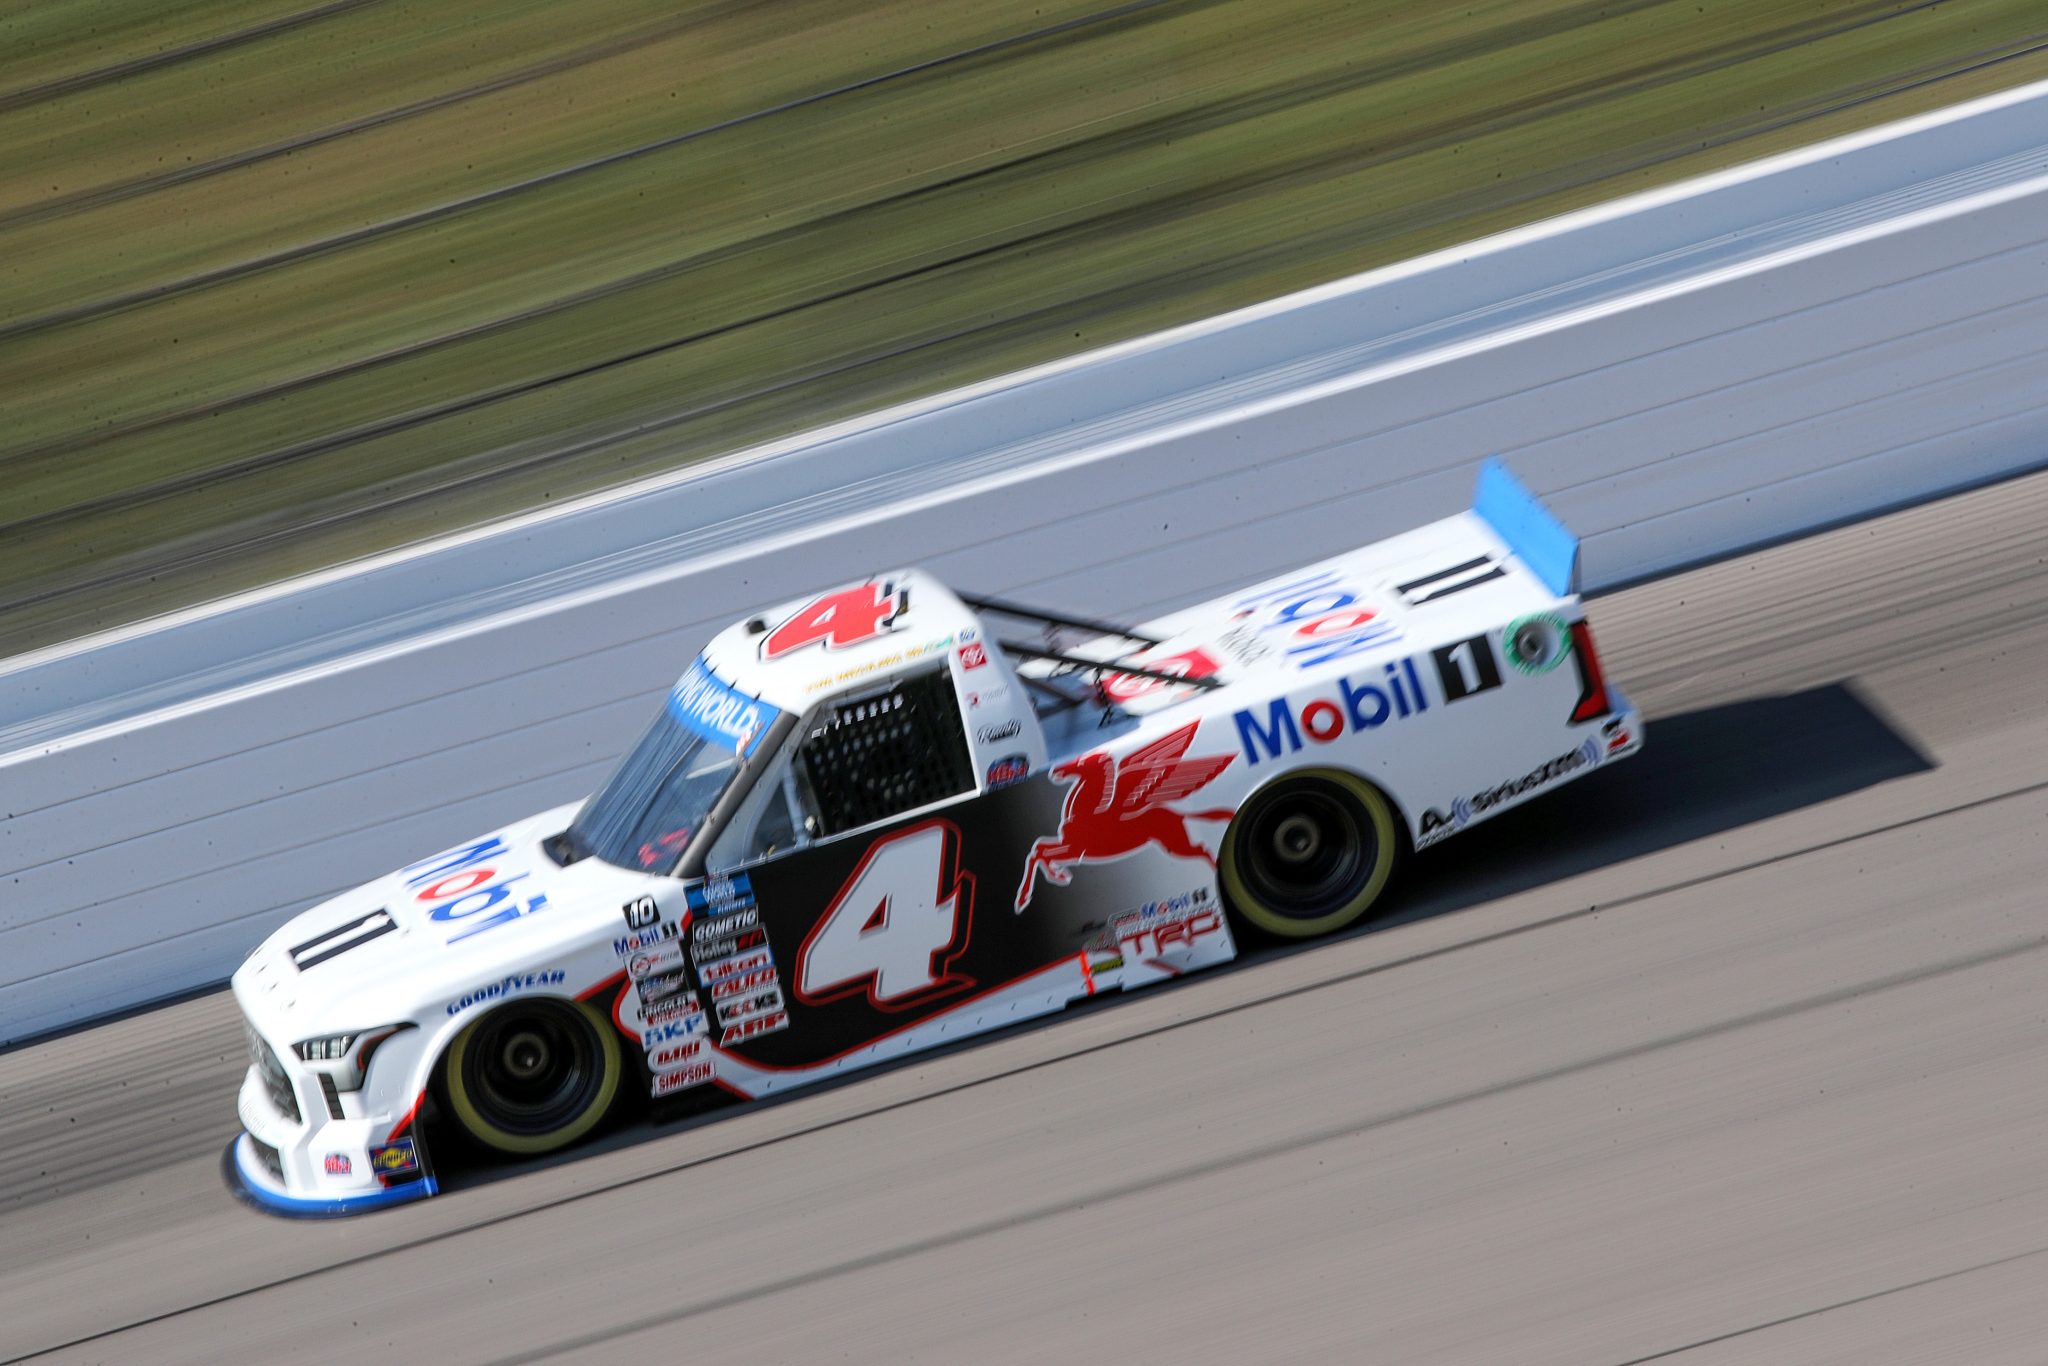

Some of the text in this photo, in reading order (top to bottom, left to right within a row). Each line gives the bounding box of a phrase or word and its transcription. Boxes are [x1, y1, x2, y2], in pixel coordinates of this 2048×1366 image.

[760, 581, 904, 662] 4
[689, 682, 761, 738] WORLD
[1232, 656, 1429, 767] Mobil
[1442, 637, 1490, 699] 1
[613, 925, 660, 958] Mobil
[794, 817, 977, 1012] 4
[446, 969, 565, 1016] GOODYEAR
[658, 1061, 711, 1090] SIMPSON
